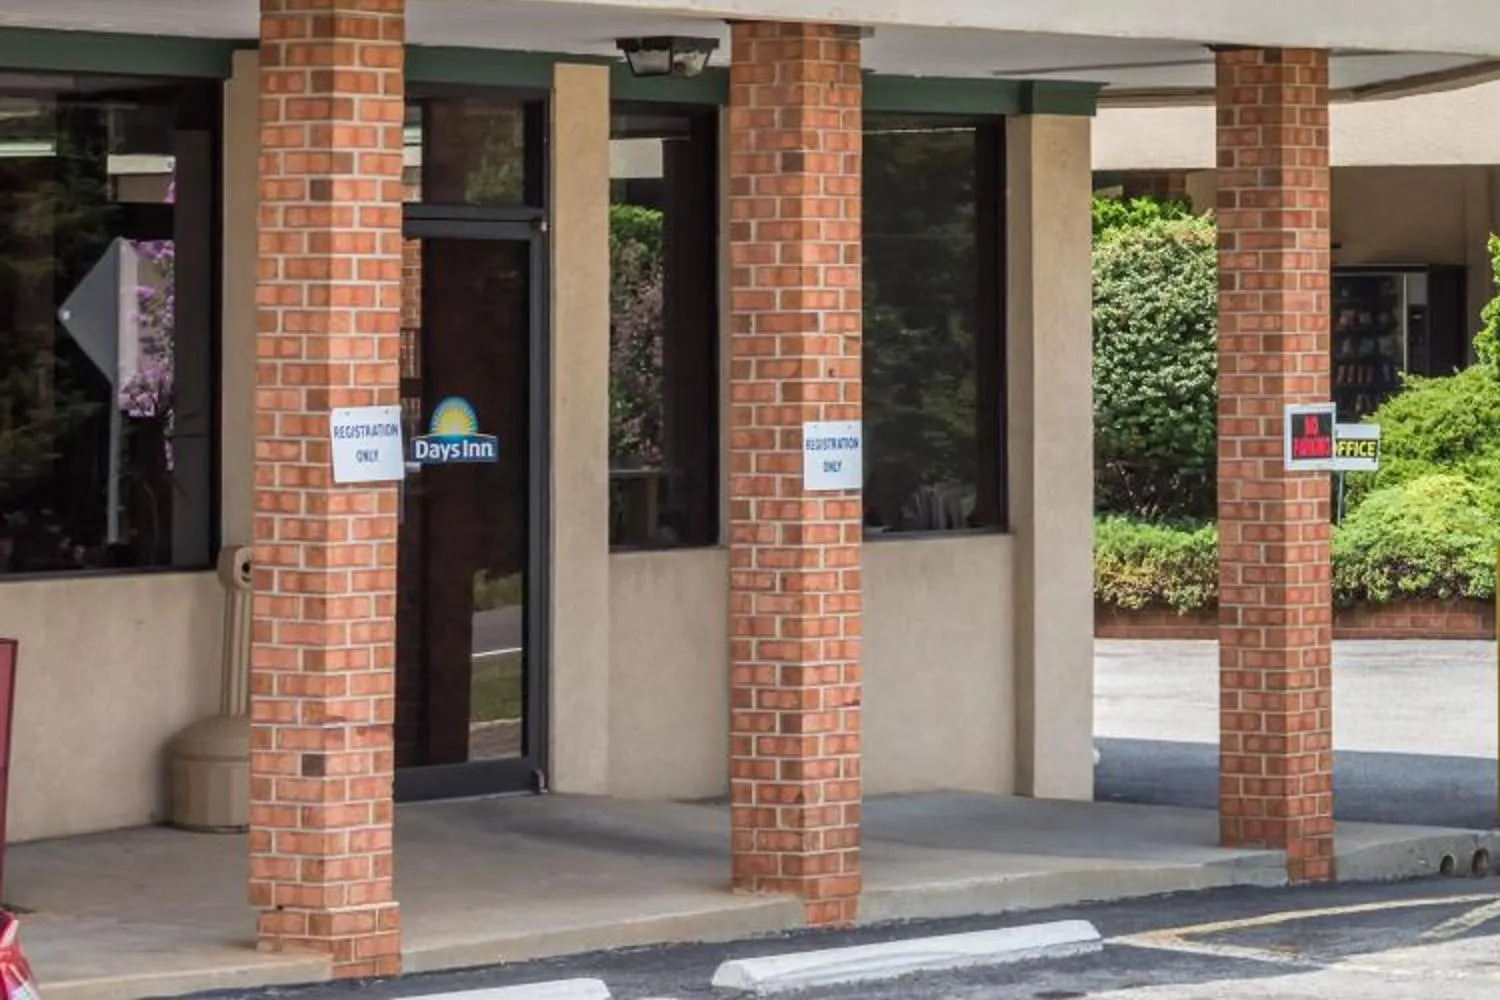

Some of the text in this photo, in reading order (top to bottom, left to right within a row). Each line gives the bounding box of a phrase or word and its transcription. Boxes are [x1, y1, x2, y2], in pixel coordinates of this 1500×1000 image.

[333, 423, 399, 439] REGISTRATION
[415, 440, 493, 461] Days Inn
[805, 437, 859, 451] REGISTRATION
[1336, 441, 1377, 458] FFICE
[355, 449, 379, 463] ONLY
